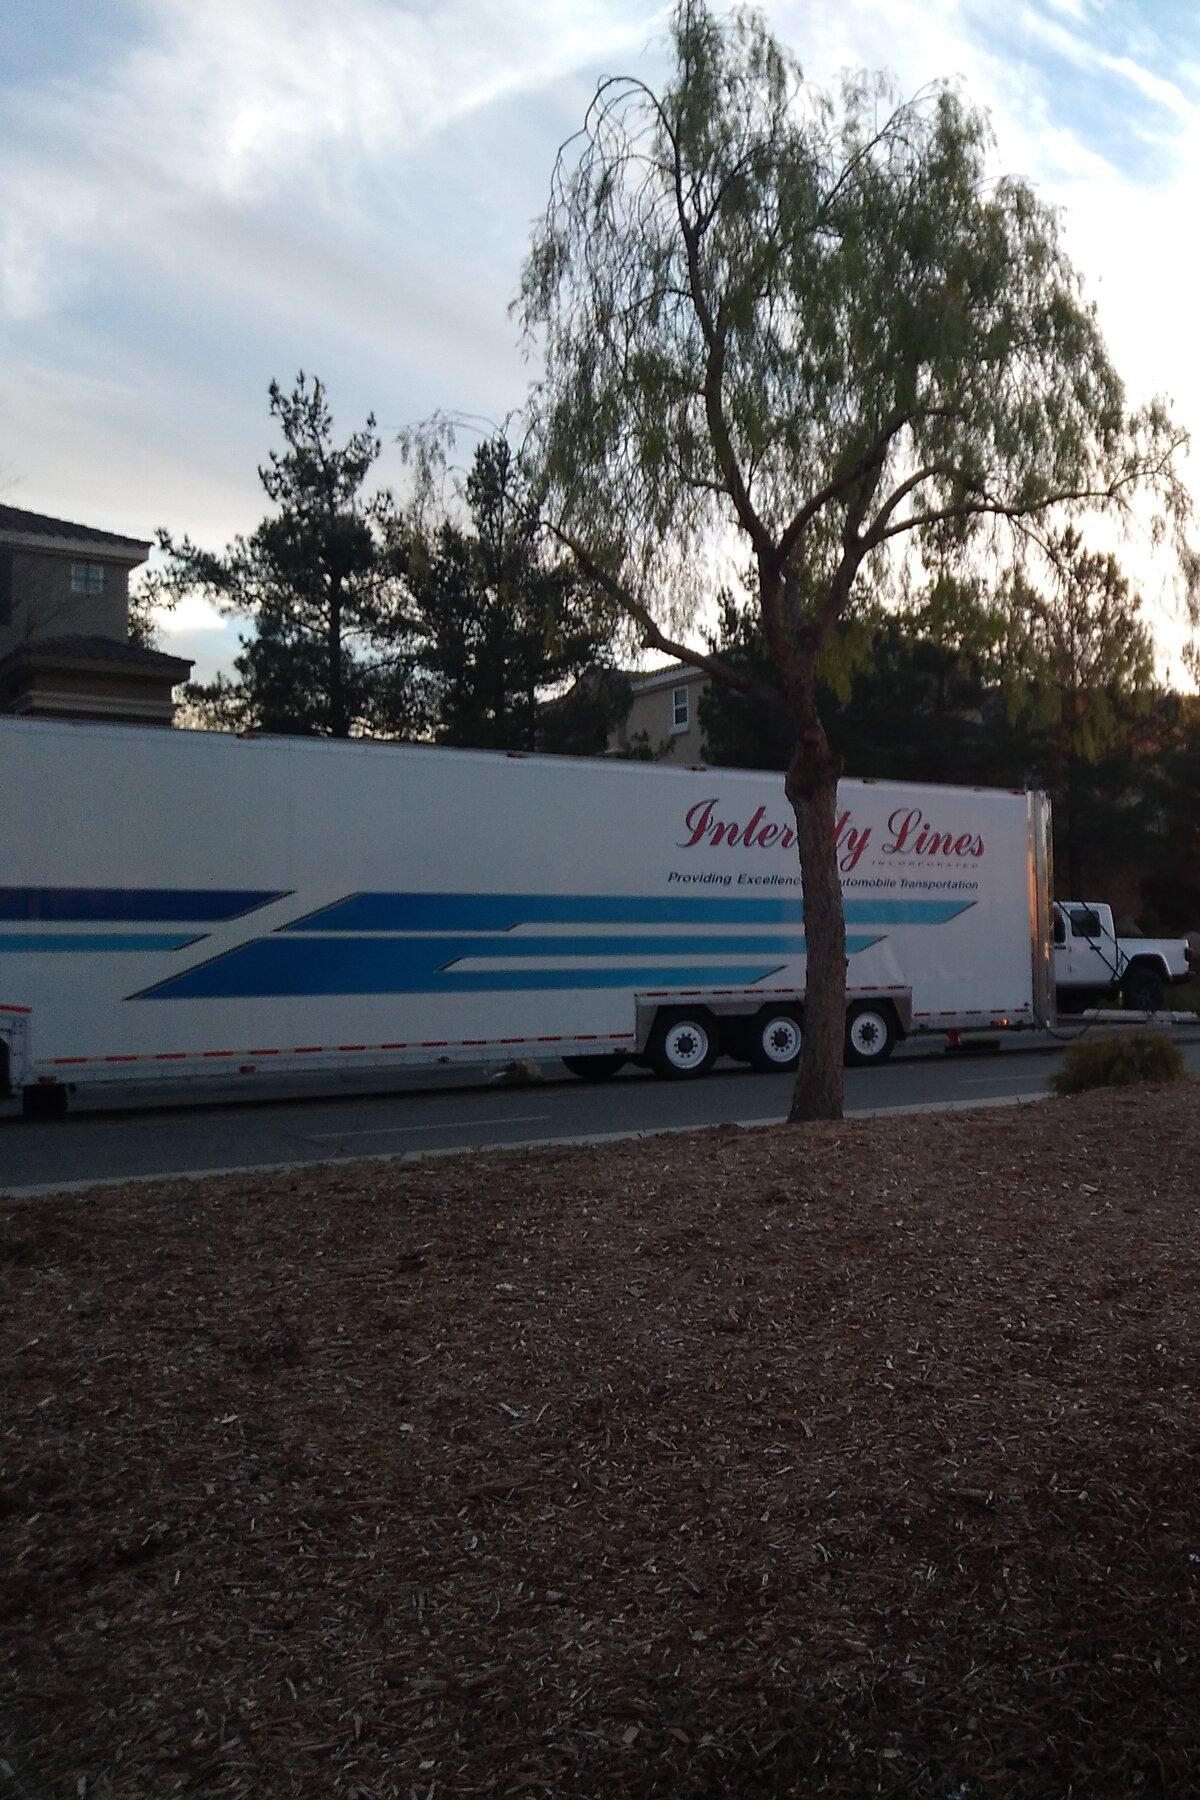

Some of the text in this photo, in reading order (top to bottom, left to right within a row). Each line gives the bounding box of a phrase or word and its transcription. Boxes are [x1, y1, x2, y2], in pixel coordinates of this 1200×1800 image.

[675, 797, 985, 872] Interty Lines
[667, 871, 980, 890] Providing Excellenc utomobile Transportation
